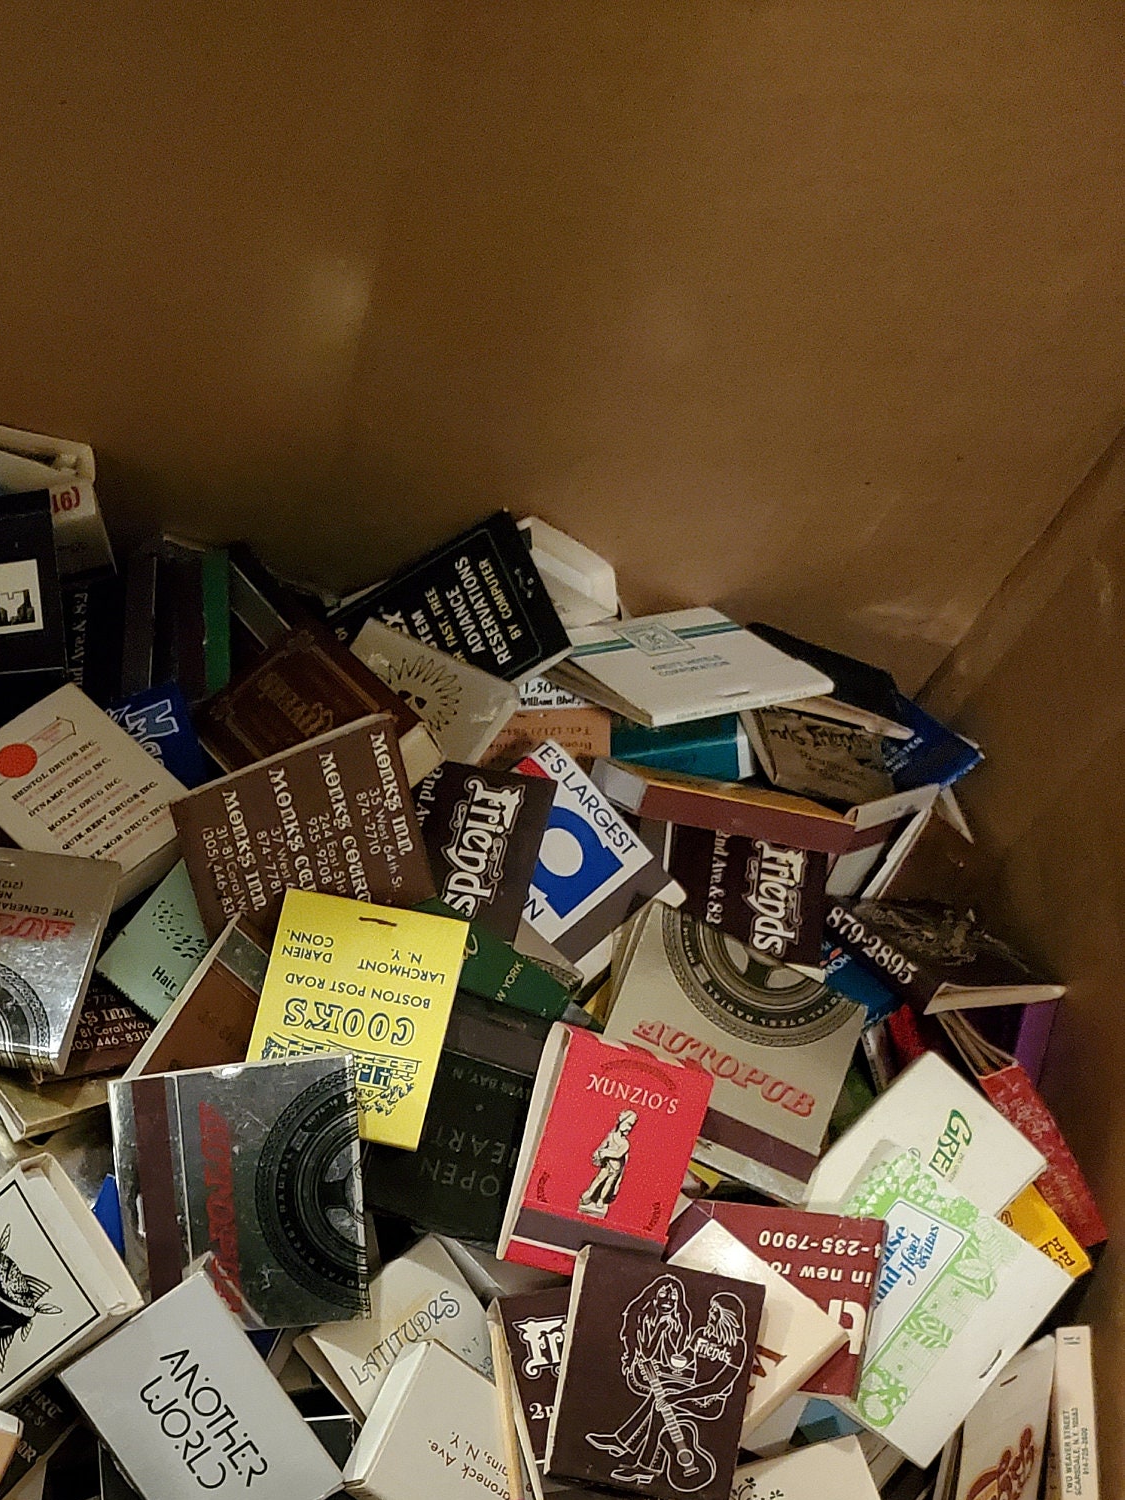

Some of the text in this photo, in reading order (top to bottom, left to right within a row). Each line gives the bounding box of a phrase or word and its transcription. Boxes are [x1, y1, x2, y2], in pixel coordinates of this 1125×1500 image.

[446, 584, 487, 654] ADVANCE
[455, 555, 512, 666] RESERVATIONS
[478, 558, 523, 641] BY COMPUTER
[24, 767, 94, 818] DYNAMIC DRUG
[44, 787, 106, 833] MORAY DRUG
[562, 773, 638, 855] LARGEST
[355, 791, 381, 856] 874-2710
[439, 777, 525, 919] Friends
[256, 830, 284, 896] 874-7781
[742, 839, 808, 956] Friends
[282, 946, 333, 964] DARIEN
[287, 929, 334, 948] CONN.
[826, 906, 919, 986] 879-2895
[152, 965, 179, 992] Hair
[285, 974, 431, 1010] BOSTON POST ROAD
[358, 960, 446, 985] LARCHMONT
[92, 1020, 151, 1036] Coral Way
[95, 1028, 152, 1048] 446-8310
[284, 998, 416, 1045] COOK'S
[632, 1018, 815, 1118] AUTOPUB
[586, 1074, 679, 1115] NUNZIO'S
[798, 1264, 872, 1288] in new
[694, 1337, 732, 1364] Friends
[140, 1376, 227, 1489] WORLD
[159, 1349, 268, 1487] ANOTHER
[427, 1439, 458, 1468] Ave.
